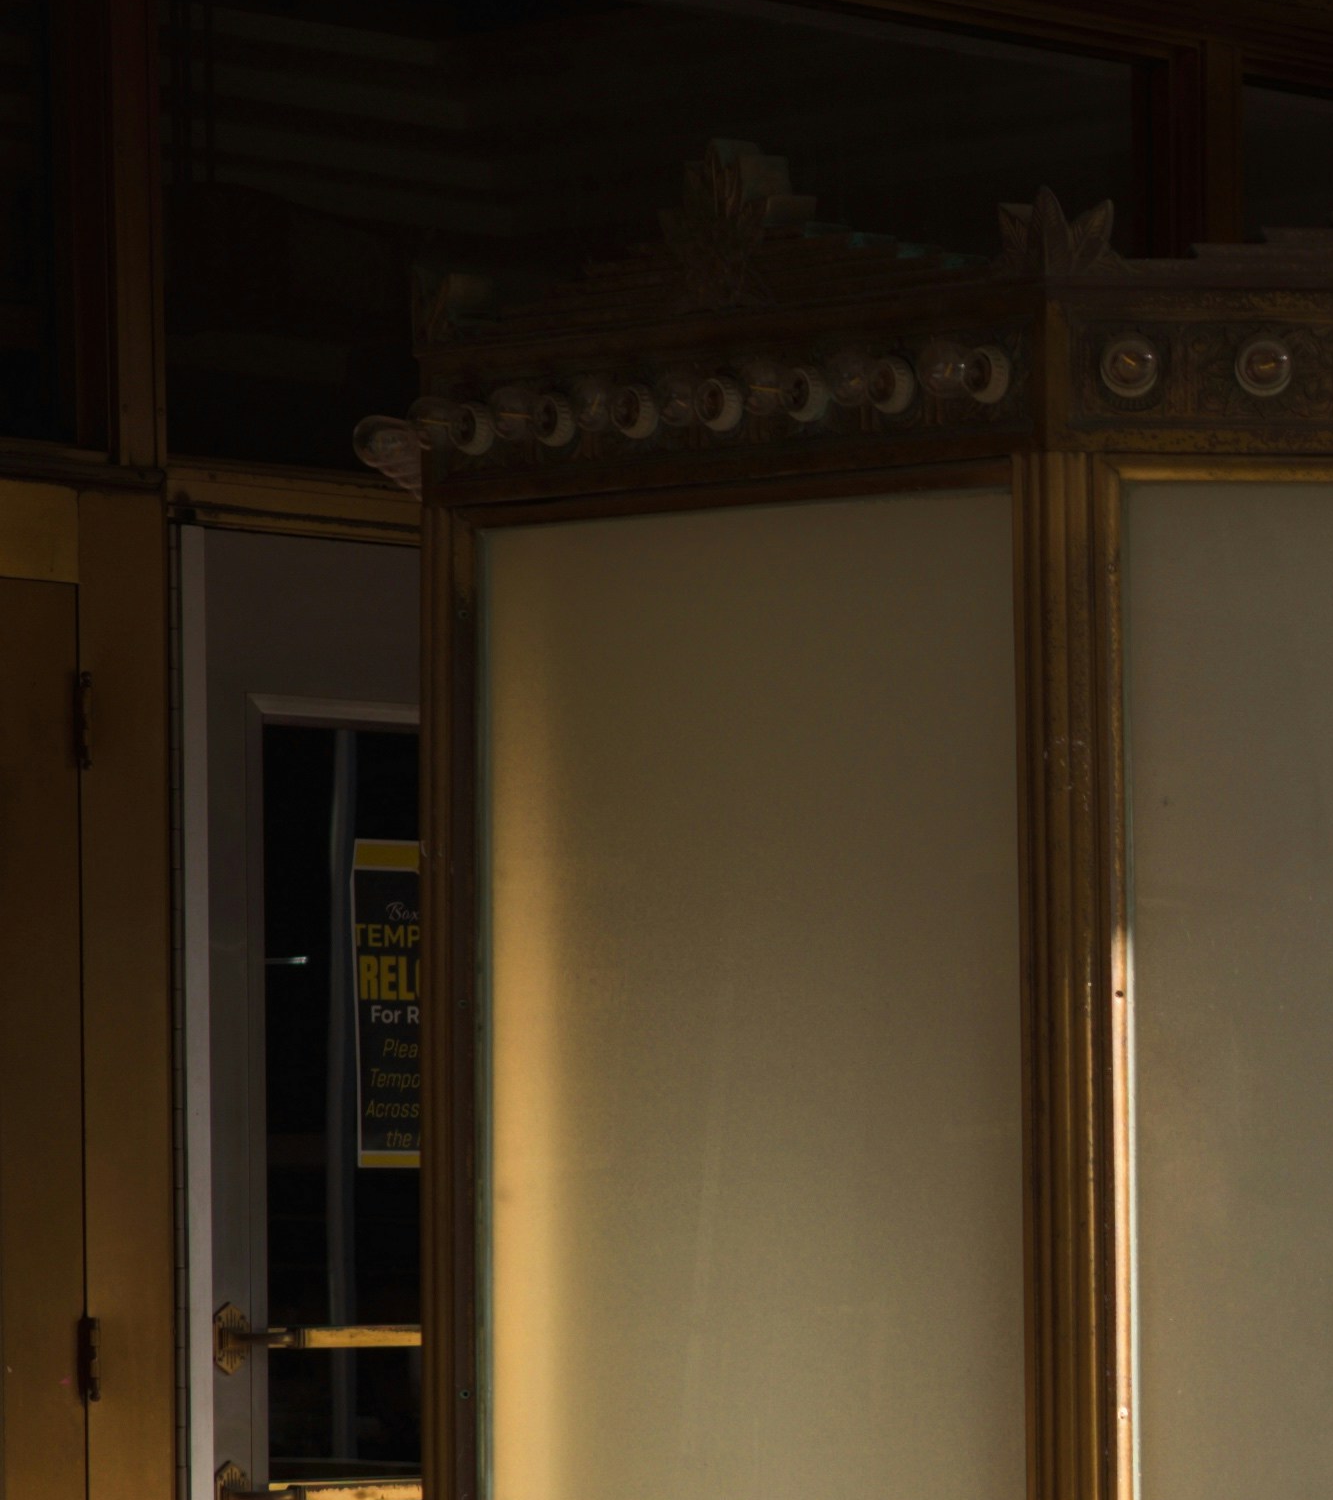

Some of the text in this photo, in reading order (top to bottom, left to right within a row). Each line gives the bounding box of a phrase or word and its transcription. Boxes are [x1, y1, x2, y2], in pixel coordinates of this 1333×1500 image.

[386, 901, 419, 922] Box
[355, 923, 420, 948] TEMP
[371, 1005, 402, 1024] For
[370, 1068, 421, 1092] Tempo
[366, 1100, 420, 1118] Across
[386, 1129, 413, 1148] the
